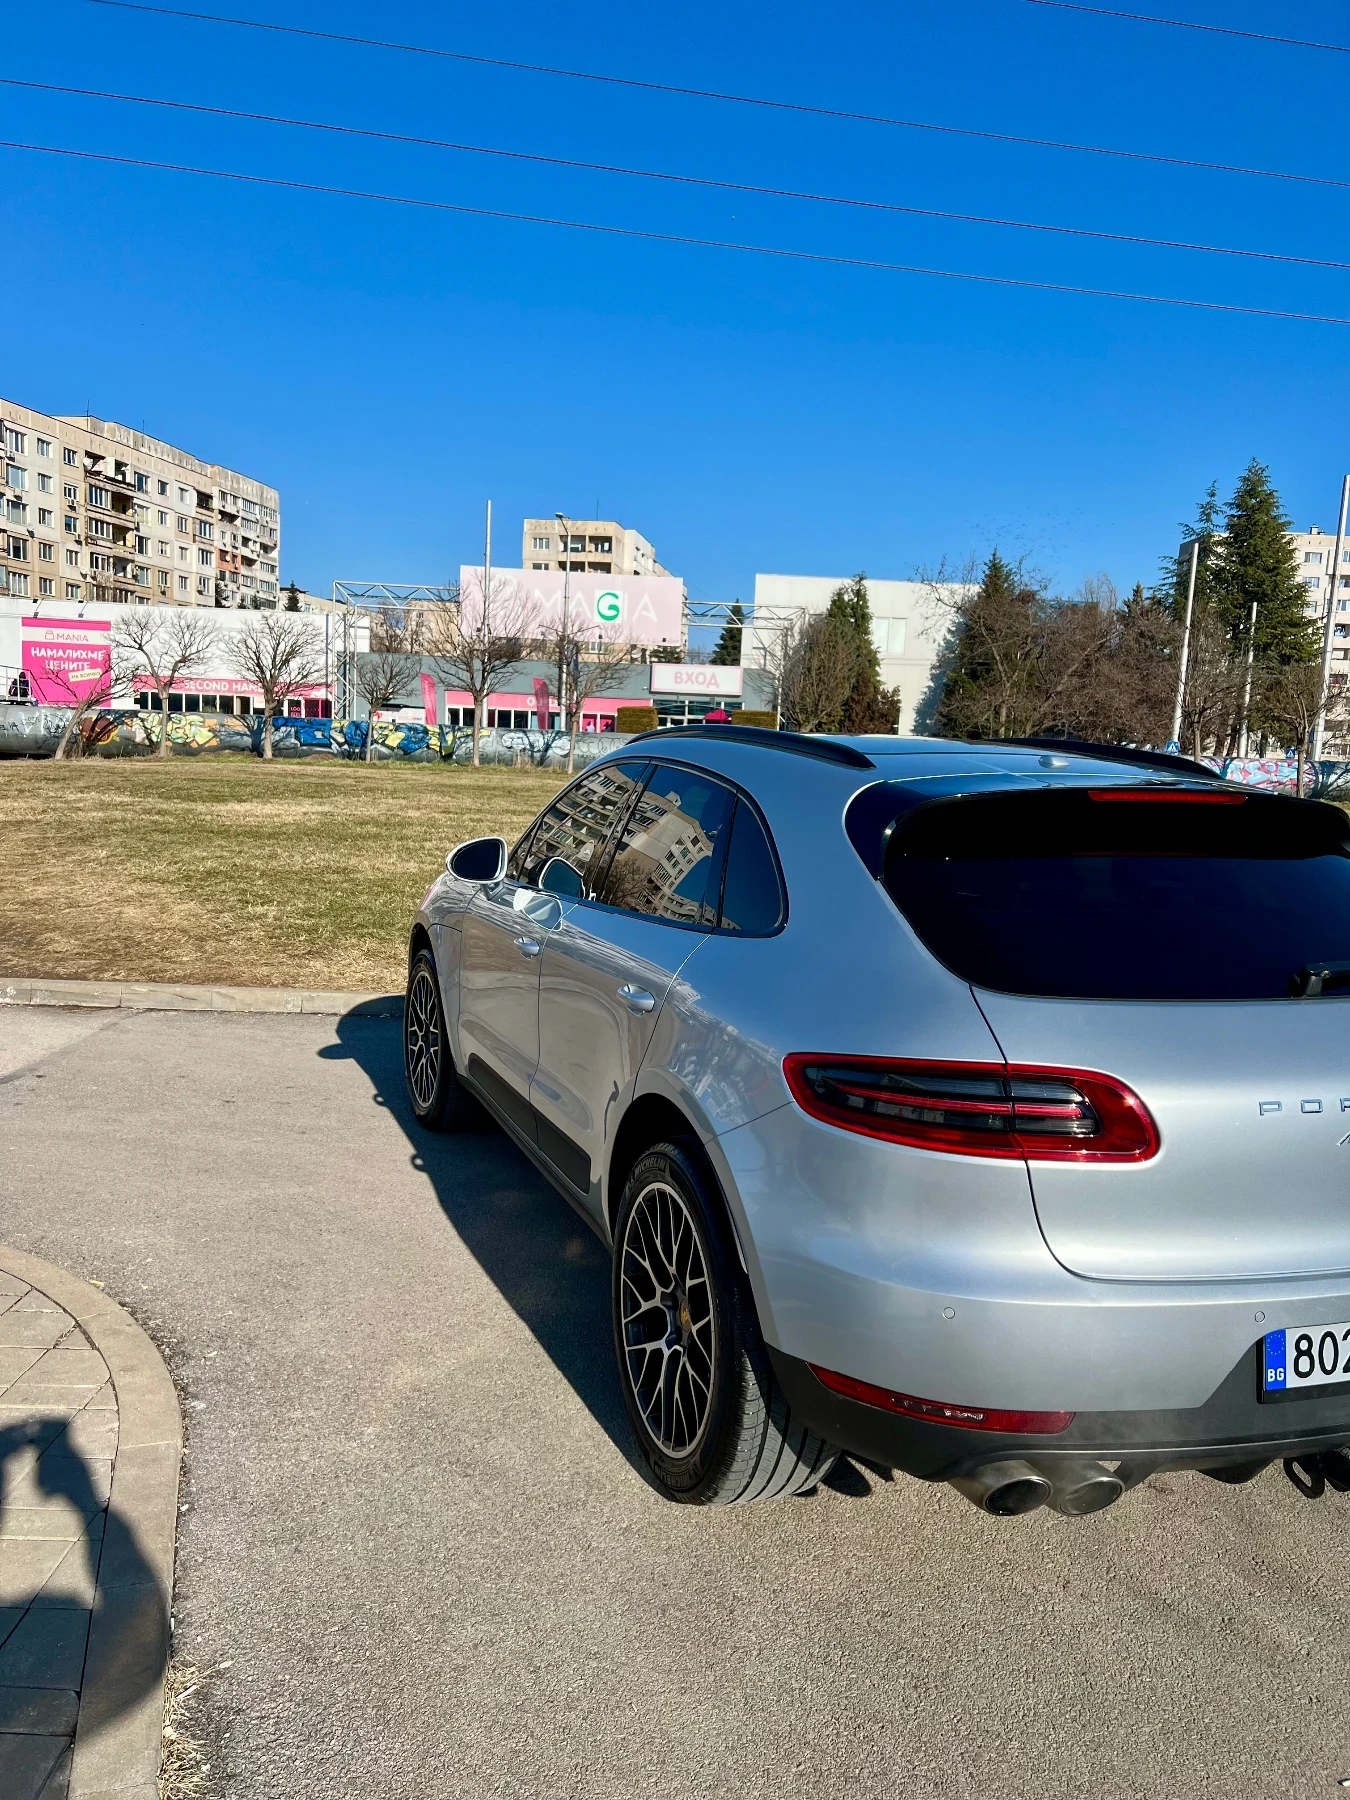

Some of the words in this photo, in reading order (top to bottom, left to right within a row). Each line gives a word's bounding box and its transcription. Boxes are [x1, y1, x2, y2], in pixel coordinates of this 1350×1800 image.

[56, 632, 89, 642] MANIA
[31, 646, 106, 661] НАМАЛИХМЕ
[45, 660, 91, 671] ЦЕНИТЕ
[183, 679, 229, 691] SECOND
[674, 671, 720, 689] ВХОД
[634, 1156, 667, 1179] MICHELIN
[1267, 1367, 1285, 1383] BG
